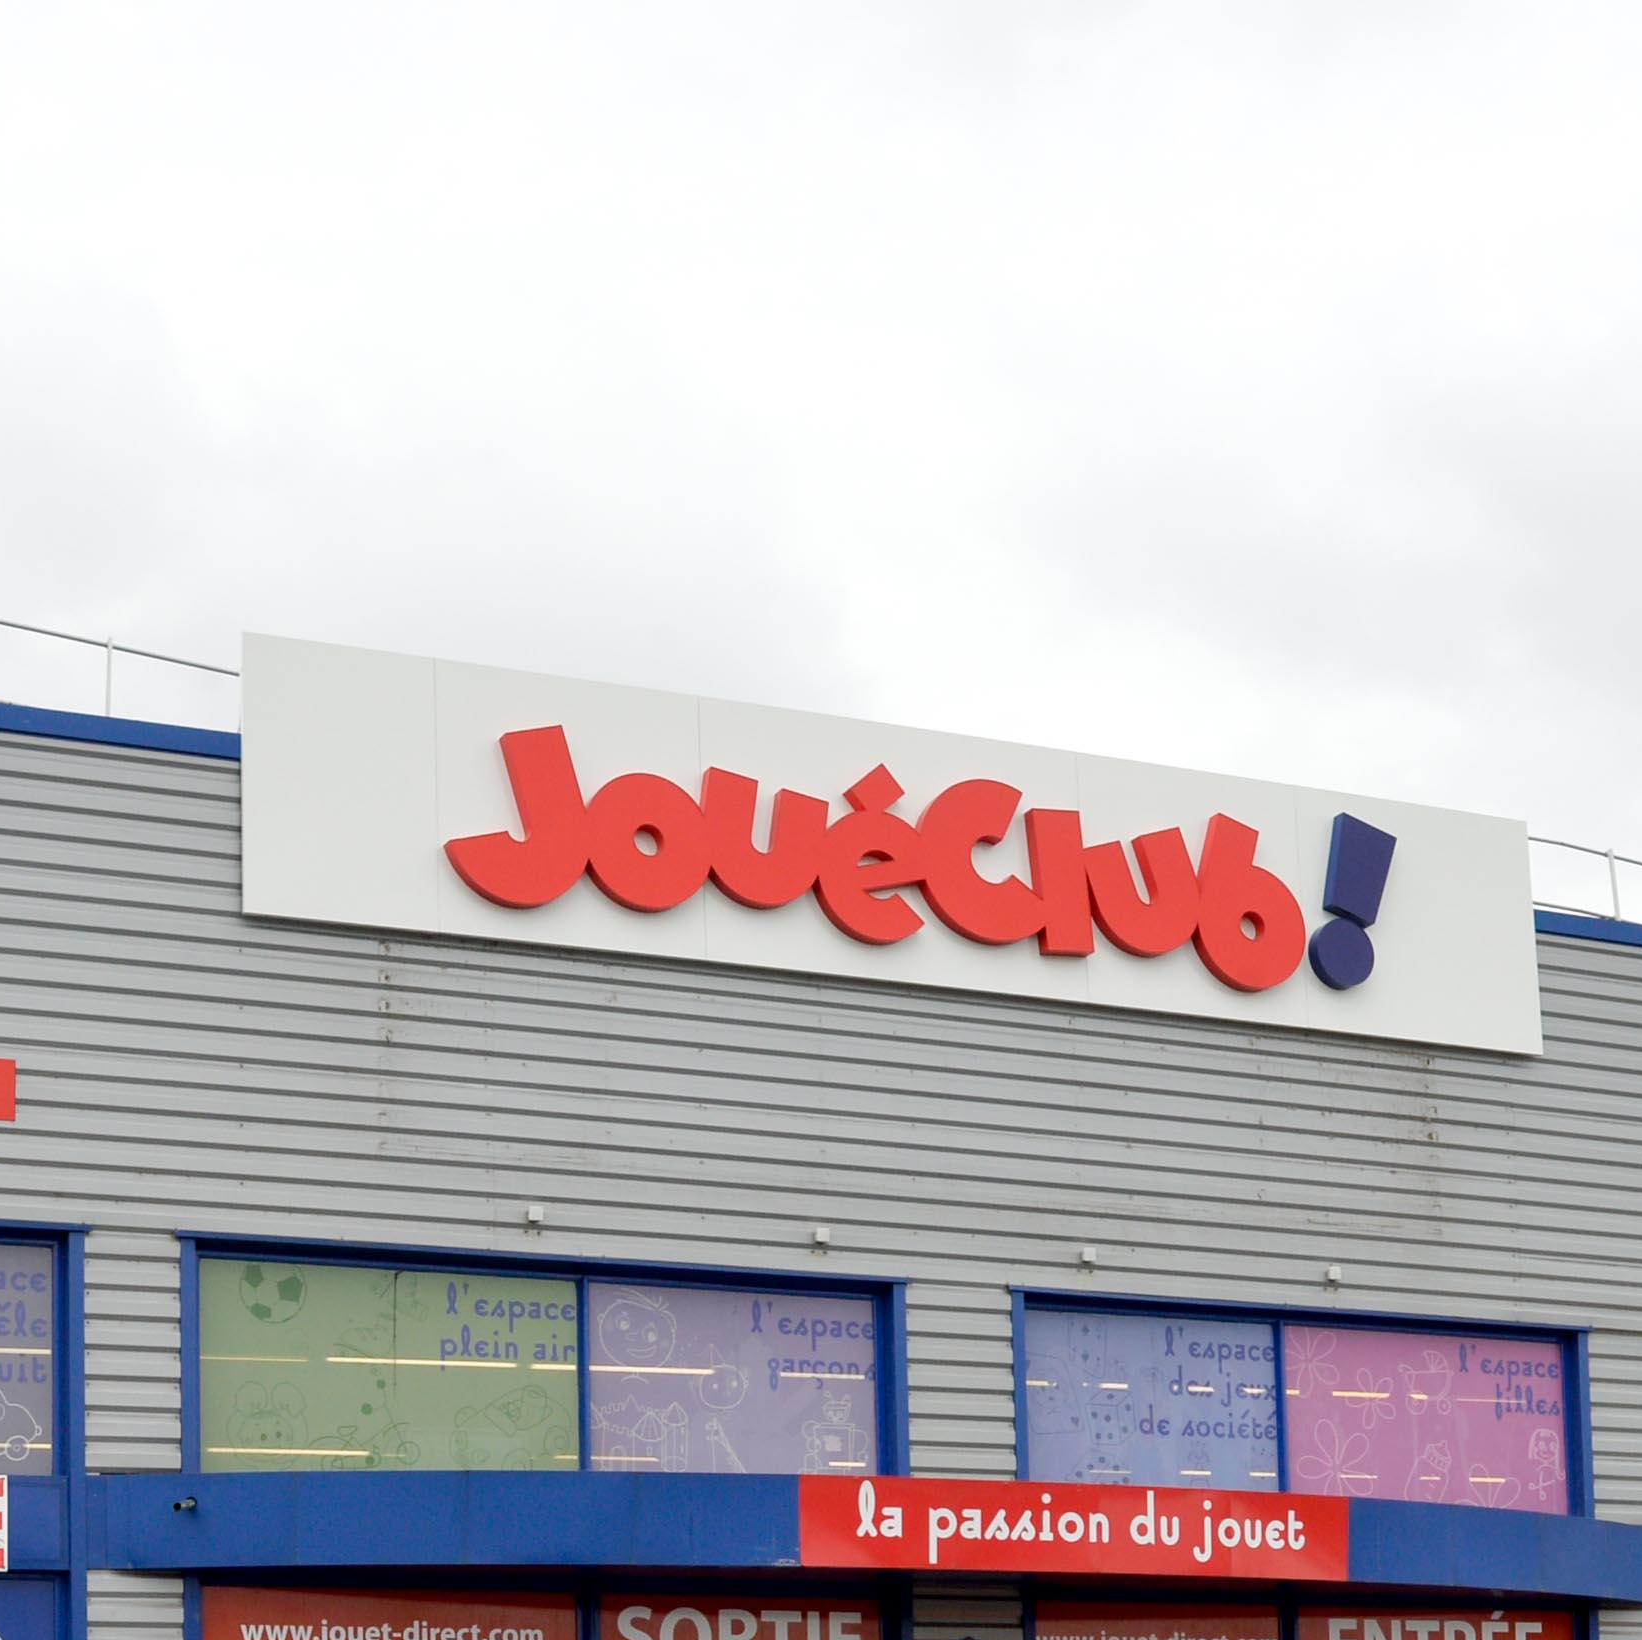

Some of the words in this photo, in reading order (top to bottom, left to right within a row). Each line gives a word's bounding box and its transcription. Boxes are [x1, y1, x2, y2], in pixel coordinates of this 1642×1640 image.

[443, 724, 1397, 992] JouéClub!
[446, 1281, 576, 1333] l'espace
[751, 1300, 875, 1352] l'espace
[440, 1324, 518, 1371] plein
[533, 1333, 576, 1361] air
[1165, 1325, 1276, 1374] l'espace
[1459, 1343, 1559, 1392] l'espace
[1169, 1365, 1214, 1397] des
[1221, 1372, 1277, 1407] jeux
[1495, 1384, 1560, 1420] filles
[1139, 1403, 1170, 1436] de
[1181, 1409, 1278, 1440] société
[856, 1480, 902, 1538] la
[928, 1493, 1110, 1564] passion
[1130, 1490, 1180, 1545] du
[1193, 1500, 1305, 1563] jouet
